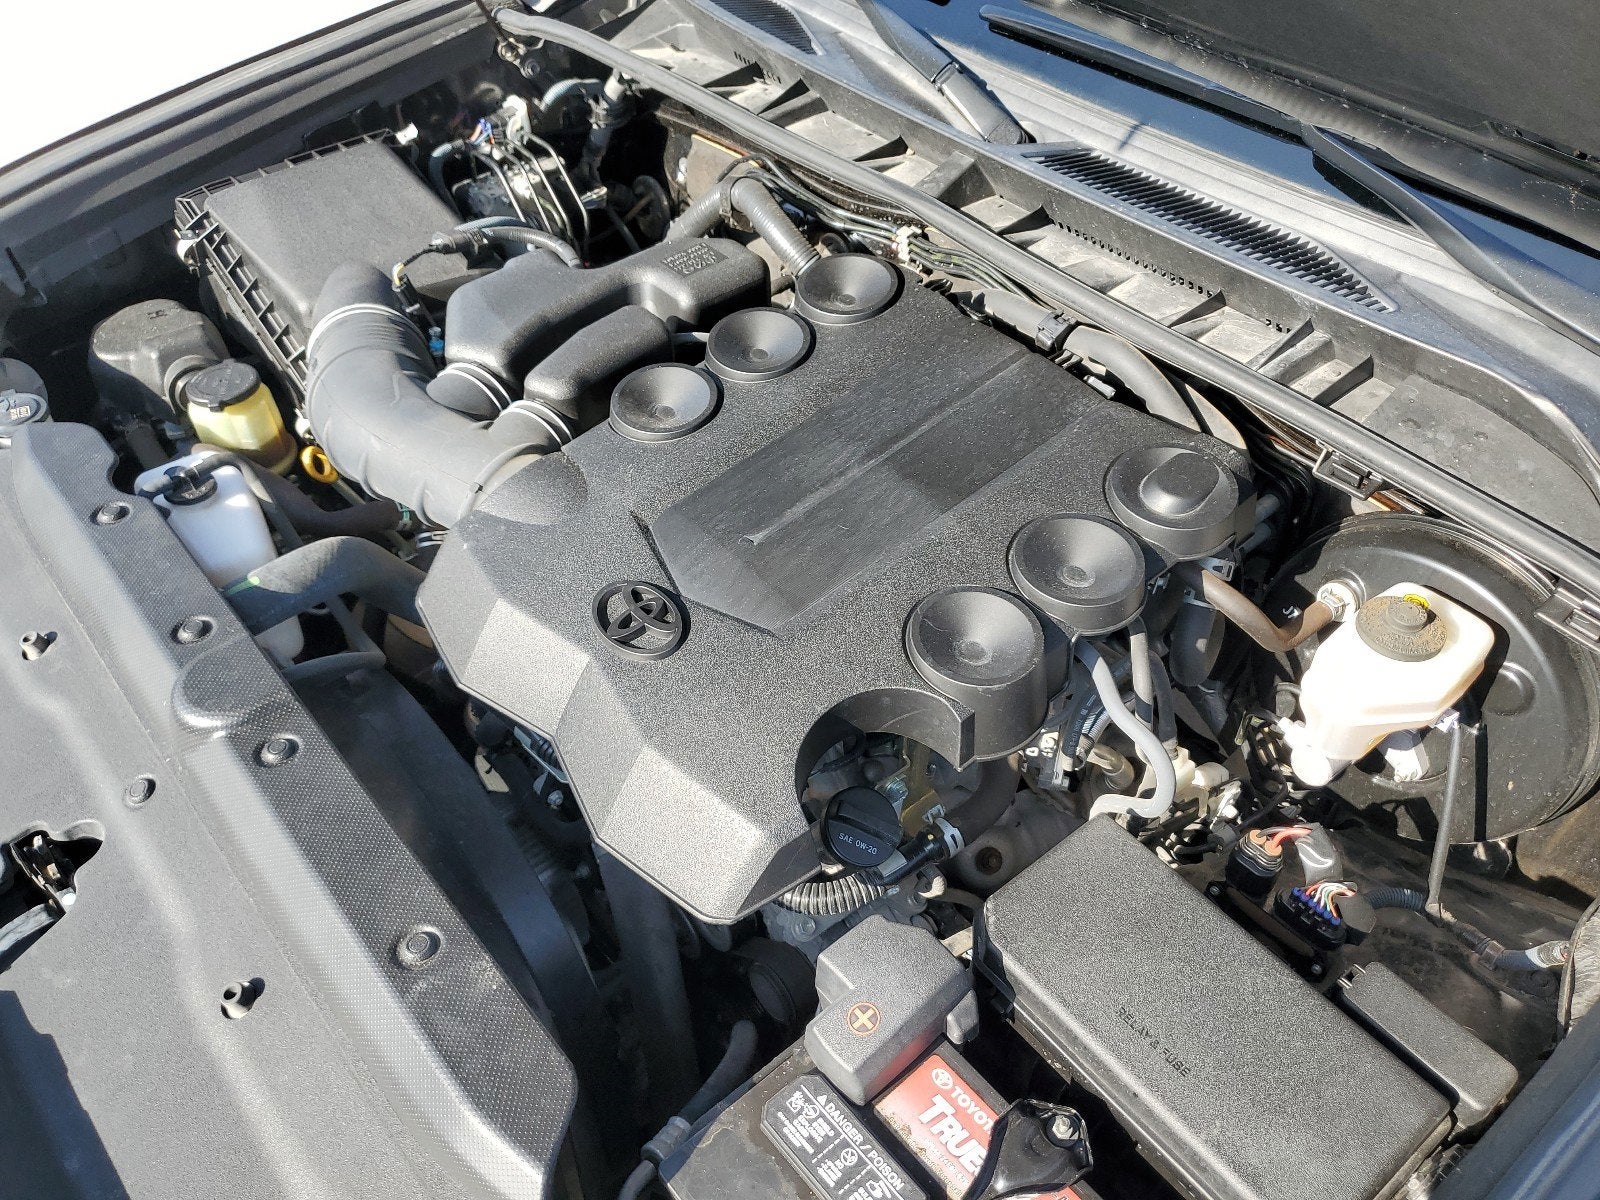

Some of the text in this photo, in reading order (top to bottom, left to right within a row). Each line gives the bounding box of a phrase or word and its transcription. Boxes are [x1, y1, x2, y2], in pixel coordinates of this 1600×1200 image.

[838, 832, 877, 855] SAE 0W-20
[1116, 1006, 1152, 1040] RELAY
[1160, 1047, 1191, 1077] FUSE
[918, 1093, 988, 1177] TRUE
[950, 1085, 993, 1134] TOYOT
[824, 1101, 864, 1146] DANGER
[867, 1149, 905, 1191] POISON
